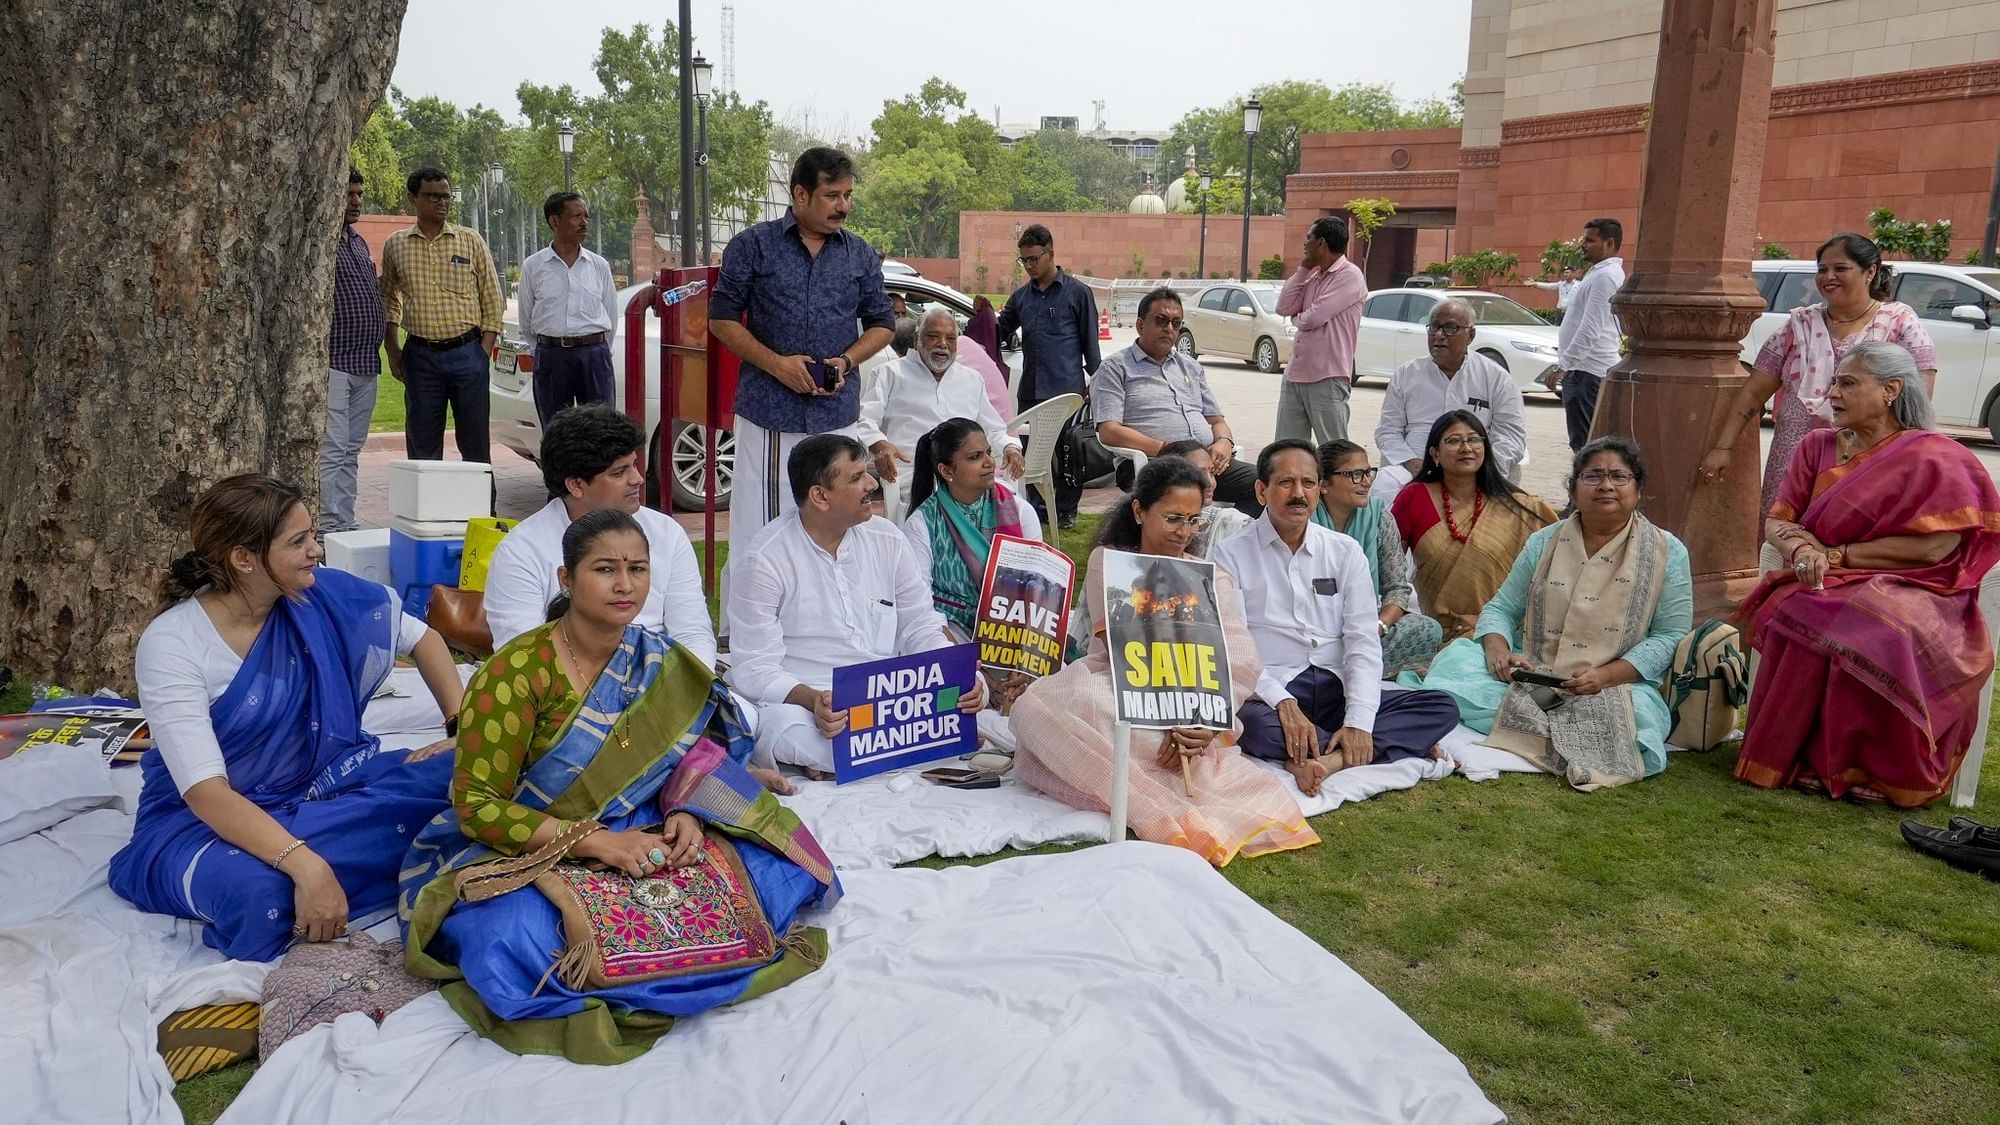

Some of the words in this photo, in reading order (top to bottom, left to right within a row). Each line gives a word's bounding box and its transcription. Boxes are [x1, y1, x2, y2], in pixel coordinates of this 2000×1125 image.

[989, 595, 1060, 638] SAVE
[978, 621, 1061, 661] MANIPUR
[980, 643, 1052, 677] WOMEN
[867, 662, 945, 700] INDIA
[1124, 641, 1221, 691] SAVE
[877, 691, 934, 727] FOR
[1122, 690, 1227, 724] MANIPUR
[849, 713, 961, 759] MANIPUR
